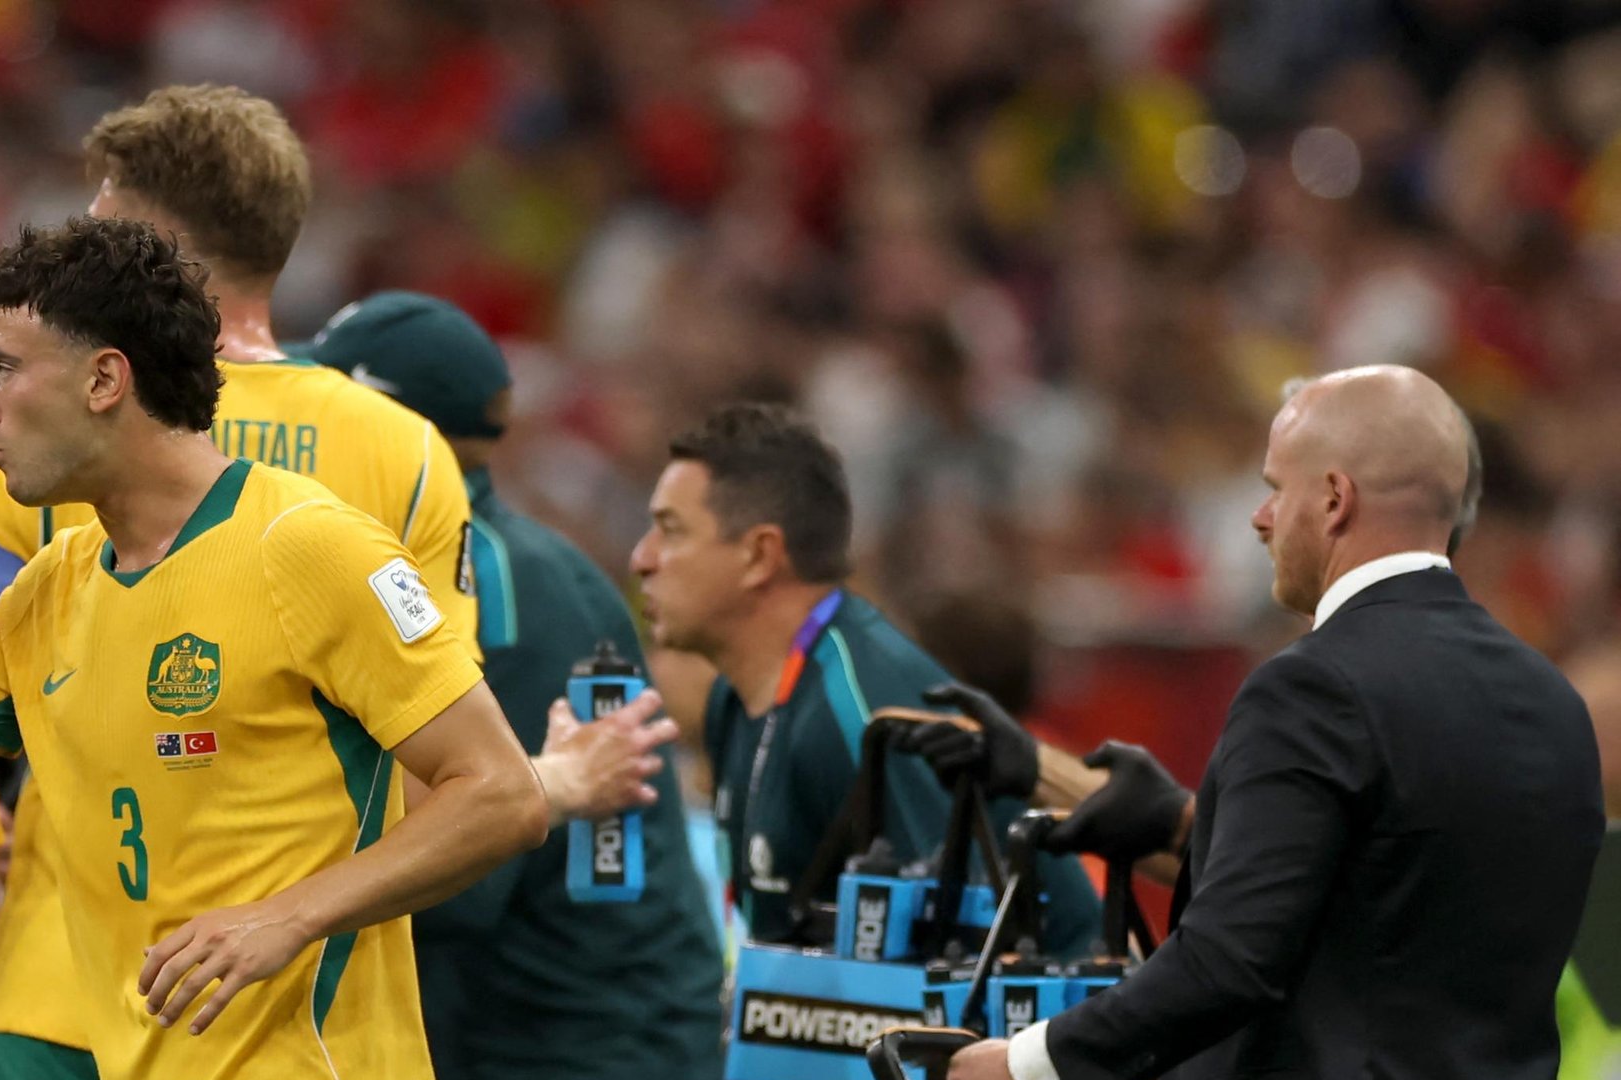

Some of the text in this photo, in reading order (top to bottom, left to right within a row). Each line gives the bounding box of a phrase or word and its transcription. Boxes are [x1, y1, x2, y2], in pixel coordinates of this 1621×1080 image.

[156, 684, 207, 694] AUSTRALIA
[111, 786, 149, 902] 3
[743, 999, 923, 1048] POWERA
